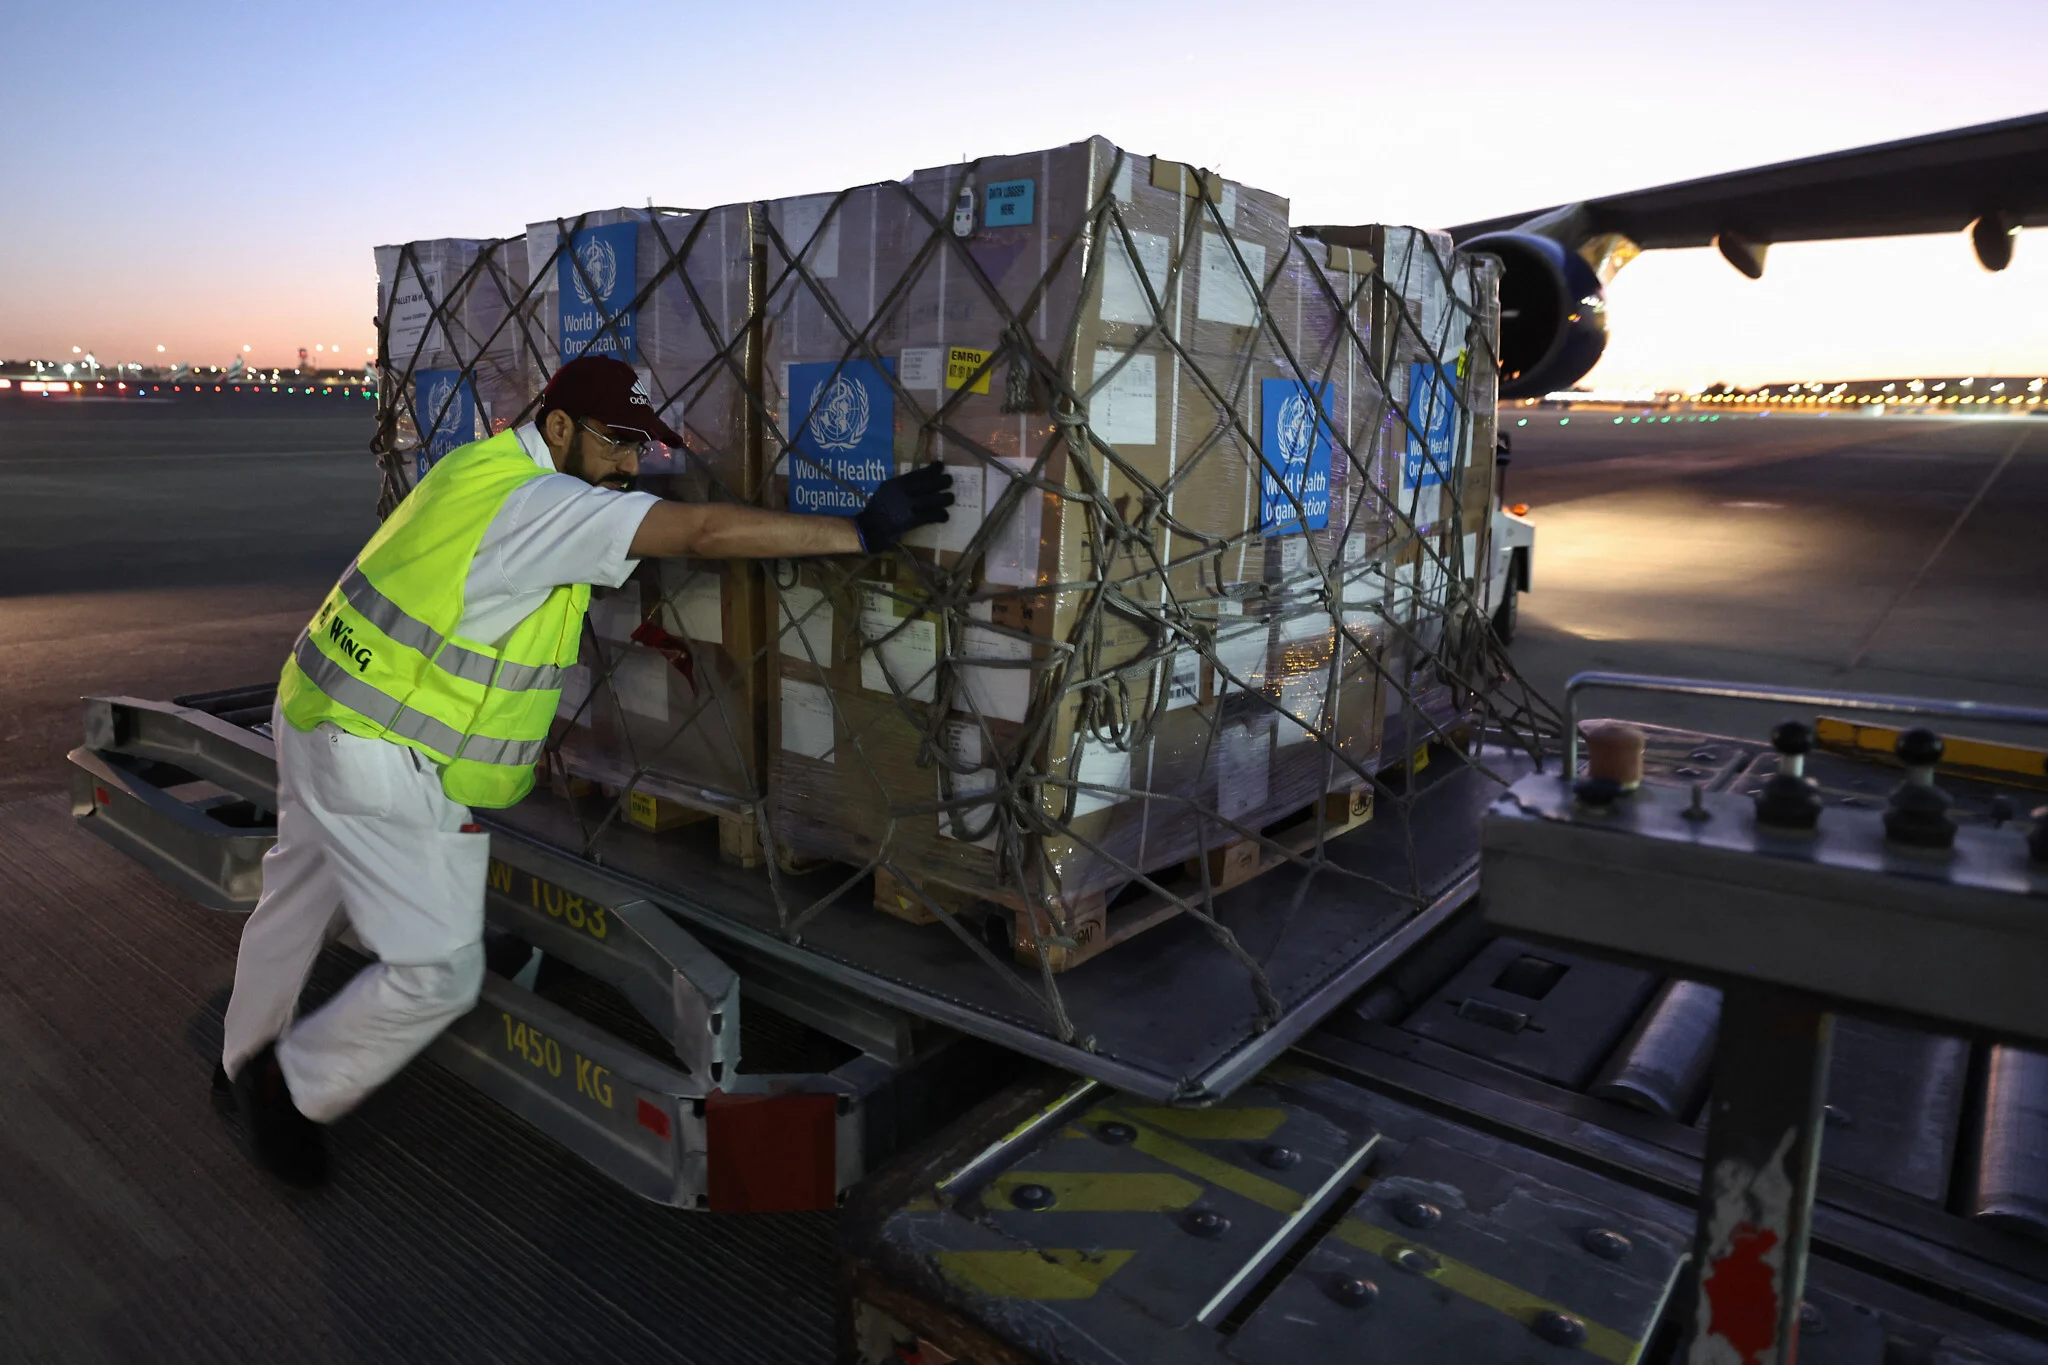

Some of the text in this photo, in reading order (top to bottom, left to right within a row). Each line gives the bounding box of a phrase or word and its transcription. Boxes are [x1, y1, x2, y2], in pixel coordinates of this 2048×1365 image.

[564, 308, 630, 333] World Halth
[951, 350, 981, 364] EMRO
[795, 458, 887, 481] World Health
[1265, 473, 1294, 496] Wold
[795, 485, 874, 511] Organizati
[1265, 496, 1327, 526] Oganiation
[503, 1012, 613, 1109] 1450 KG
